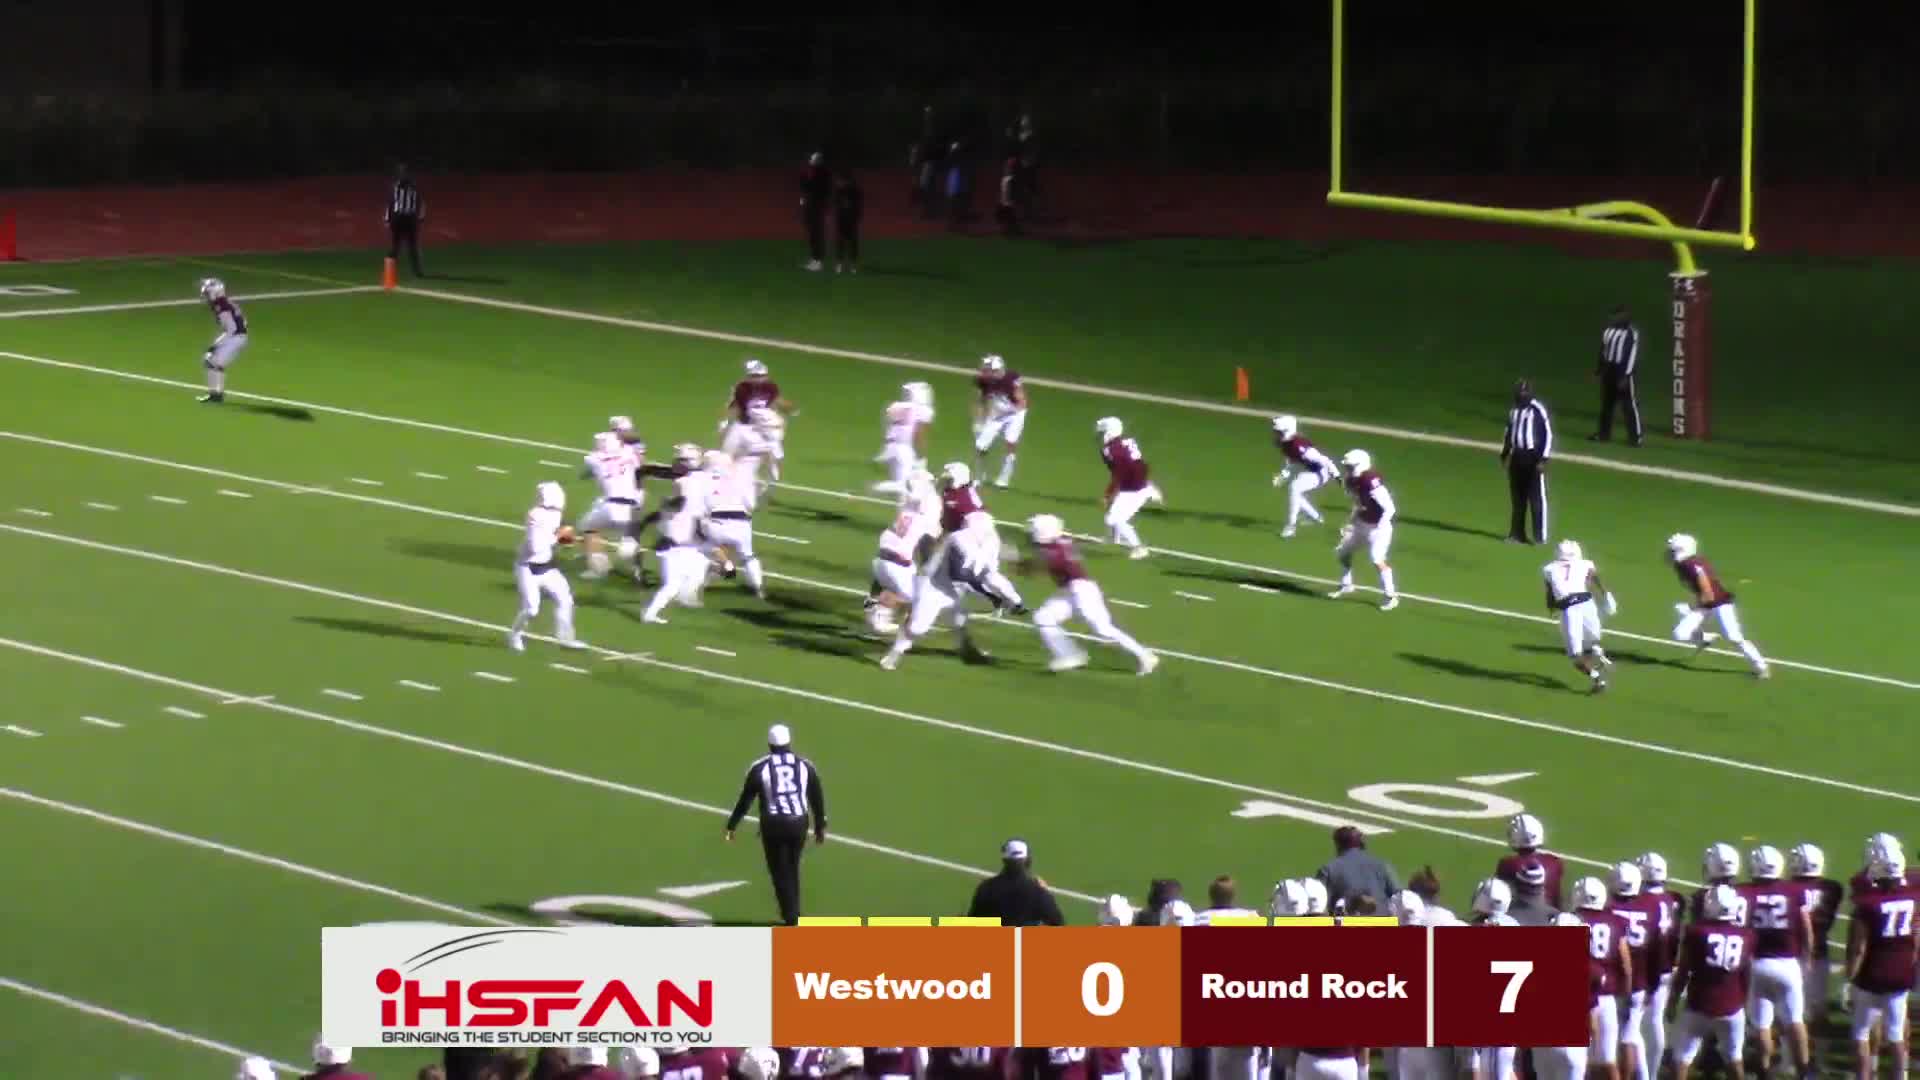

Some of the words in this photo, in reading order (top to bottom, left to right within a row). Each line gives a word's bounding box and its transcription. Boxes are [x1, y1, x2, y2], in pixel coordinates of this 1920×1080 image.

[1672, 301, 1685, 434] DRAGONS
[775, 765, 798, 793] R
[1229, 782, 1526, 835] 10
[1881, 900, 1914, 937] 77
[1589, 923, 1611, 959] 8
[1706, 933, 1744, 971] 38
